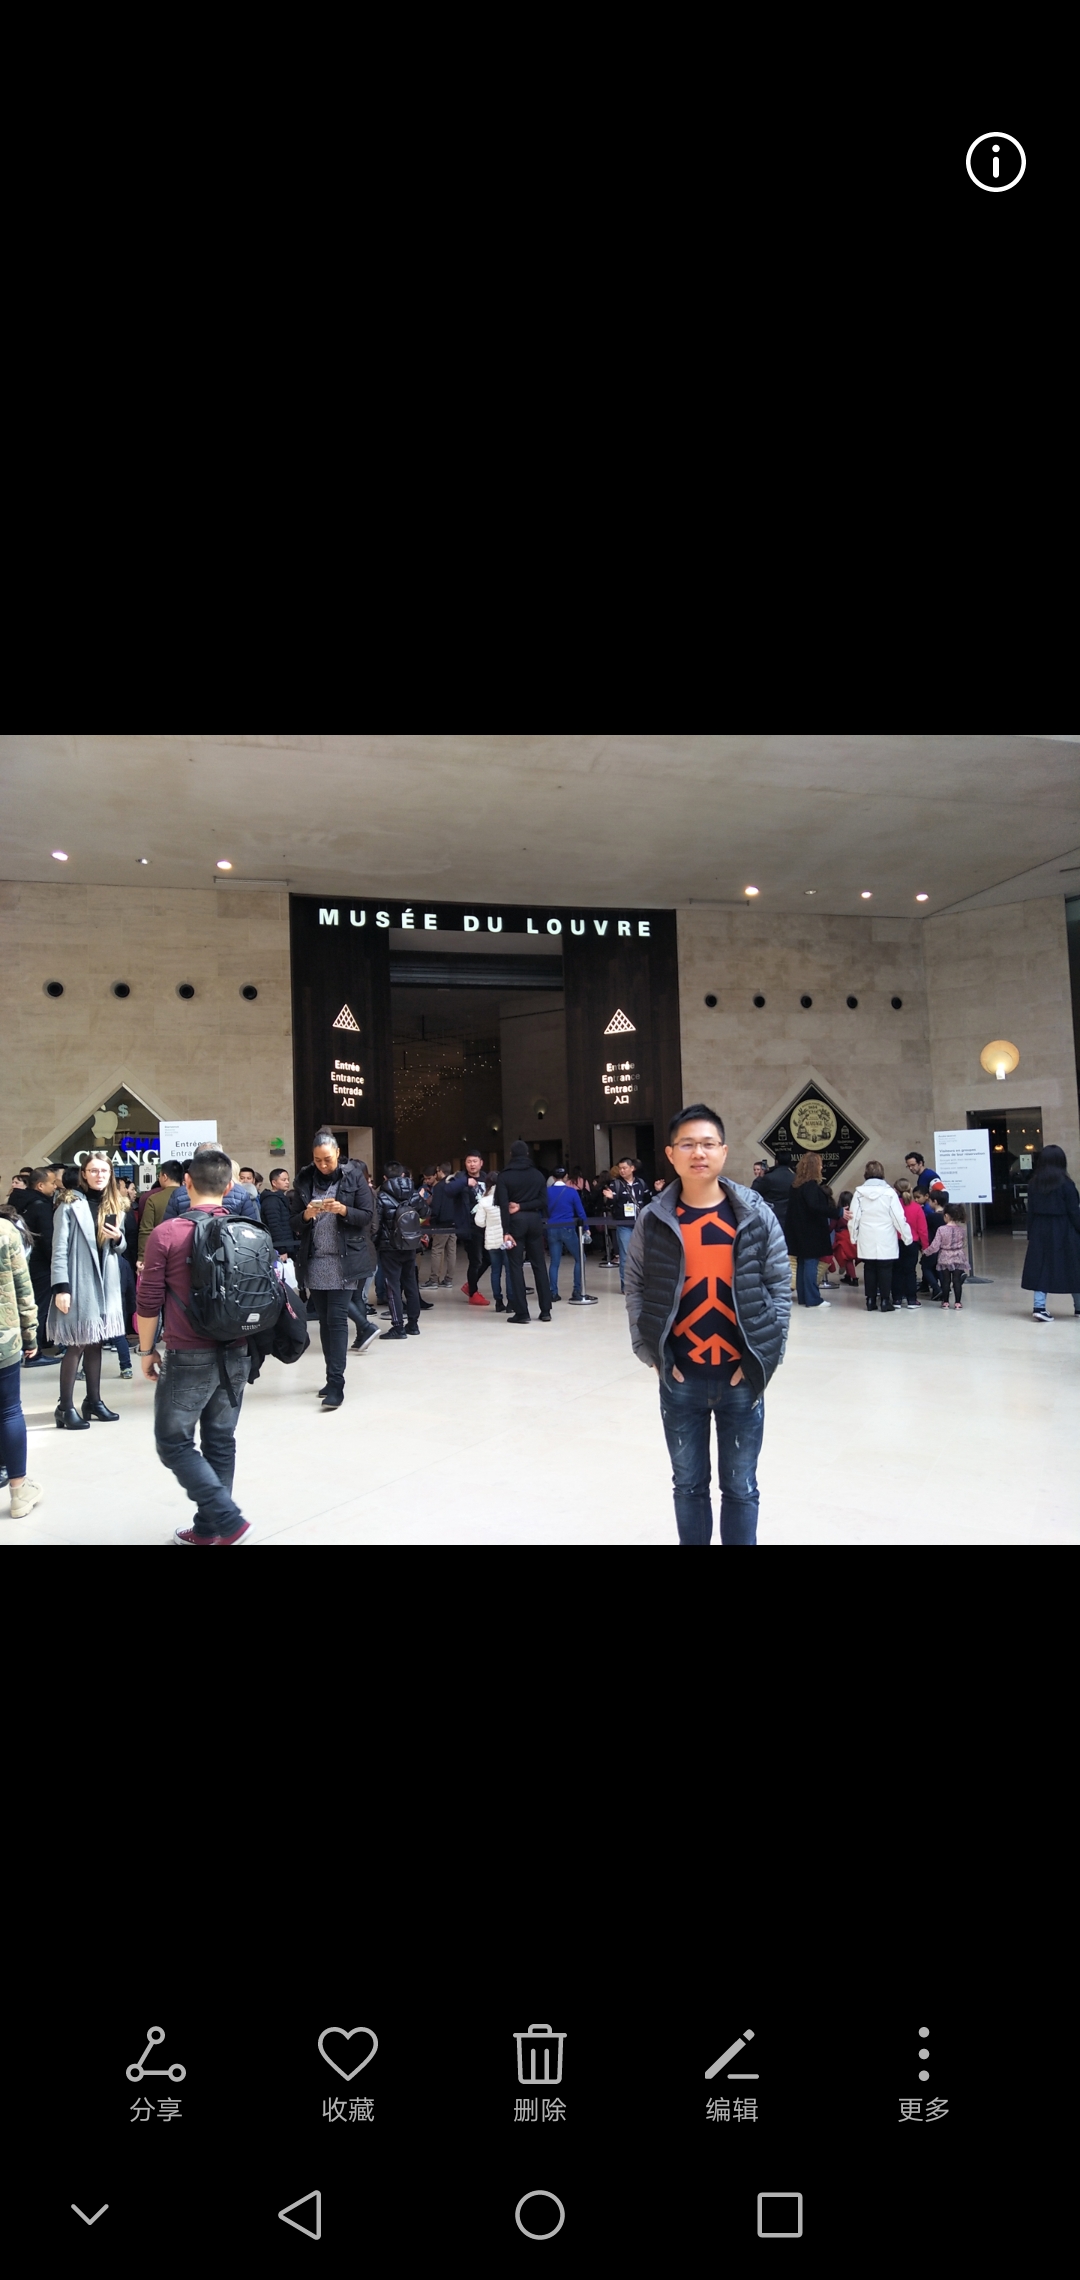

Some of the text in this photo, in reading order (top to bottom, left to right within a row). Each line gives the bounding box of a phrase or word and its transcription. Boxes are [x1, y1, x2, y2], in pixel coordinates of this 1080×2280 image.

[319, 907, 650, 937] MUSÉE DU LOUVRE
[334, 1059, 361, 1072] Entrée
[606, 1060, 636, 1072] Entrée
[330, 1071, 365, 1084] Entrance
[601, 1073, 641, 1084] Entrance
[332, 1083, 363, 1096] Entrada
[604, 1084, 639, 1095] Entrada
[341, 1096, 356, 1107] 入口
[613, 1095, 630, 1105] 入口
[822, 1151, 840, 1160] RÈRES
